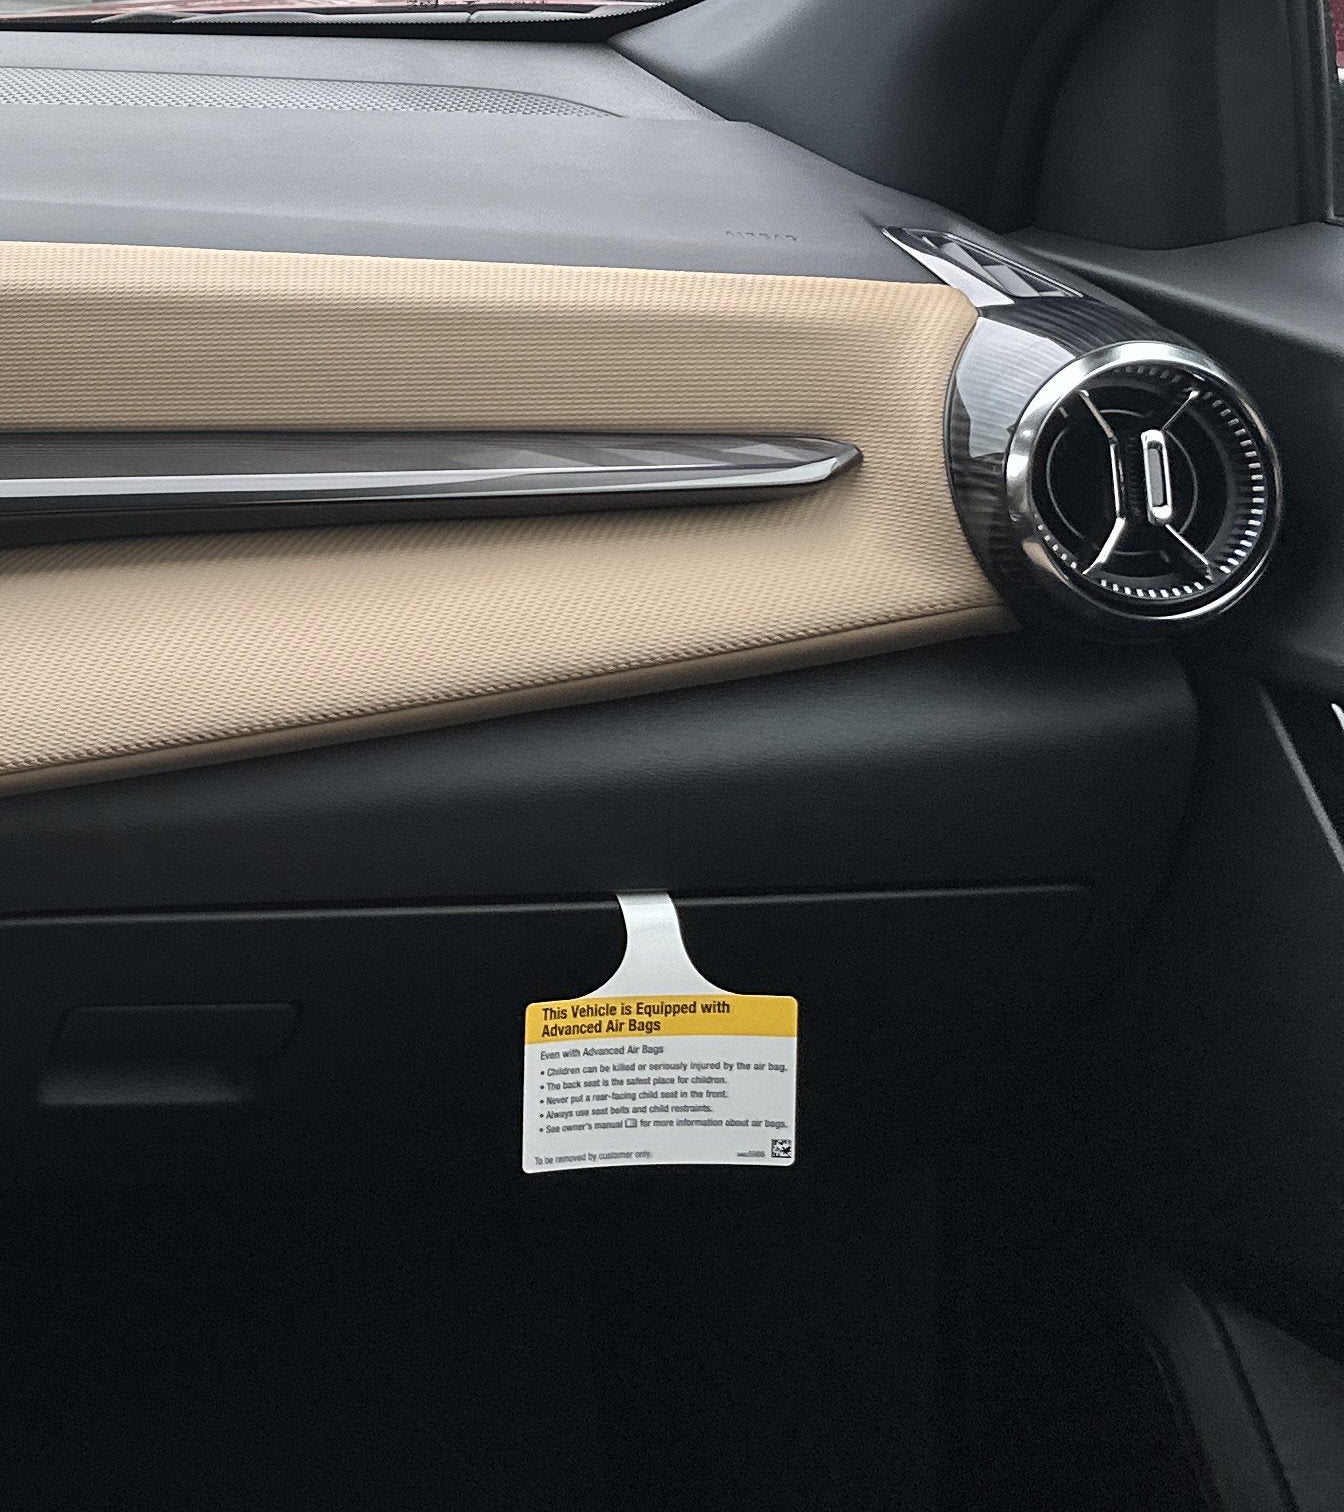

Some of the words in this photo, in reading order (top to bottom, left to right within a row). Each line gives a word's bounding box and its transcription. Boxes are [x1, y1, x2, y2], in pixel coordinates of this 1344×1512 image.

[542, 1007, 568, 1021] This
[571, 1003, 616, 1018] Vehicle
[621, 1002, 632, 1015] is
[636, 1001, 697, 1018] Equipped
[700, 1001, 731, 1014] with
[542, 1020, 602, 1037] Advanced
[606, 1020, 625, 1033] Air
[628, 1019, 661, 1033] Bags
[540, 1050, 560, 1060] Even
[562, 1048, 581, 1058] with
[582, 1046, 624, 1057] Advanced
[627, 1045, 640, 1054] Air
[642, 1044, 664, 1055] Bags
[547, 1066, 580, 1076] Children
[582, 1065, 598, 1074] can
[600, 1064, 610, 1073] be
[612, 1063, 635, 1072] killed
[638, 1063, 647, 1071] or
[649, 1062, 687, 1072] seriously
[690, 1061, 721, 1072] injured
[723, 1061, 733, 1071] by
[736, 1061, 750, 1070] the
[753, 1062, 766, 1070] air
[768, 1062, 788, 1072] bag.
[547, 1082, 560, 1091] The
[563, 1080, 581, 1089] back
[584, 1079, 600, 1087] seat
[602, 1078, 609, 1086] is
[611, 1077, 624, 1085] the
[626, 1077, 651, 1085] safest
[653, 1076, 674, 1086] place
[677, 1076, 688, 1084] for
[691, 1076, 727, 1084] children.
[546, 1096, 568, 1105] Never
[571, 1094, 583, 1104] put
[592, 1092, 636, 1101] rear-facing
[638, 1091, 658, 1099] child
[660, 1090, 678, 1098] seat
[680, 1090, 688, 1098] in
[690, 1090, 703, 1098] the
[706, 1089, 728, 1098] front.
